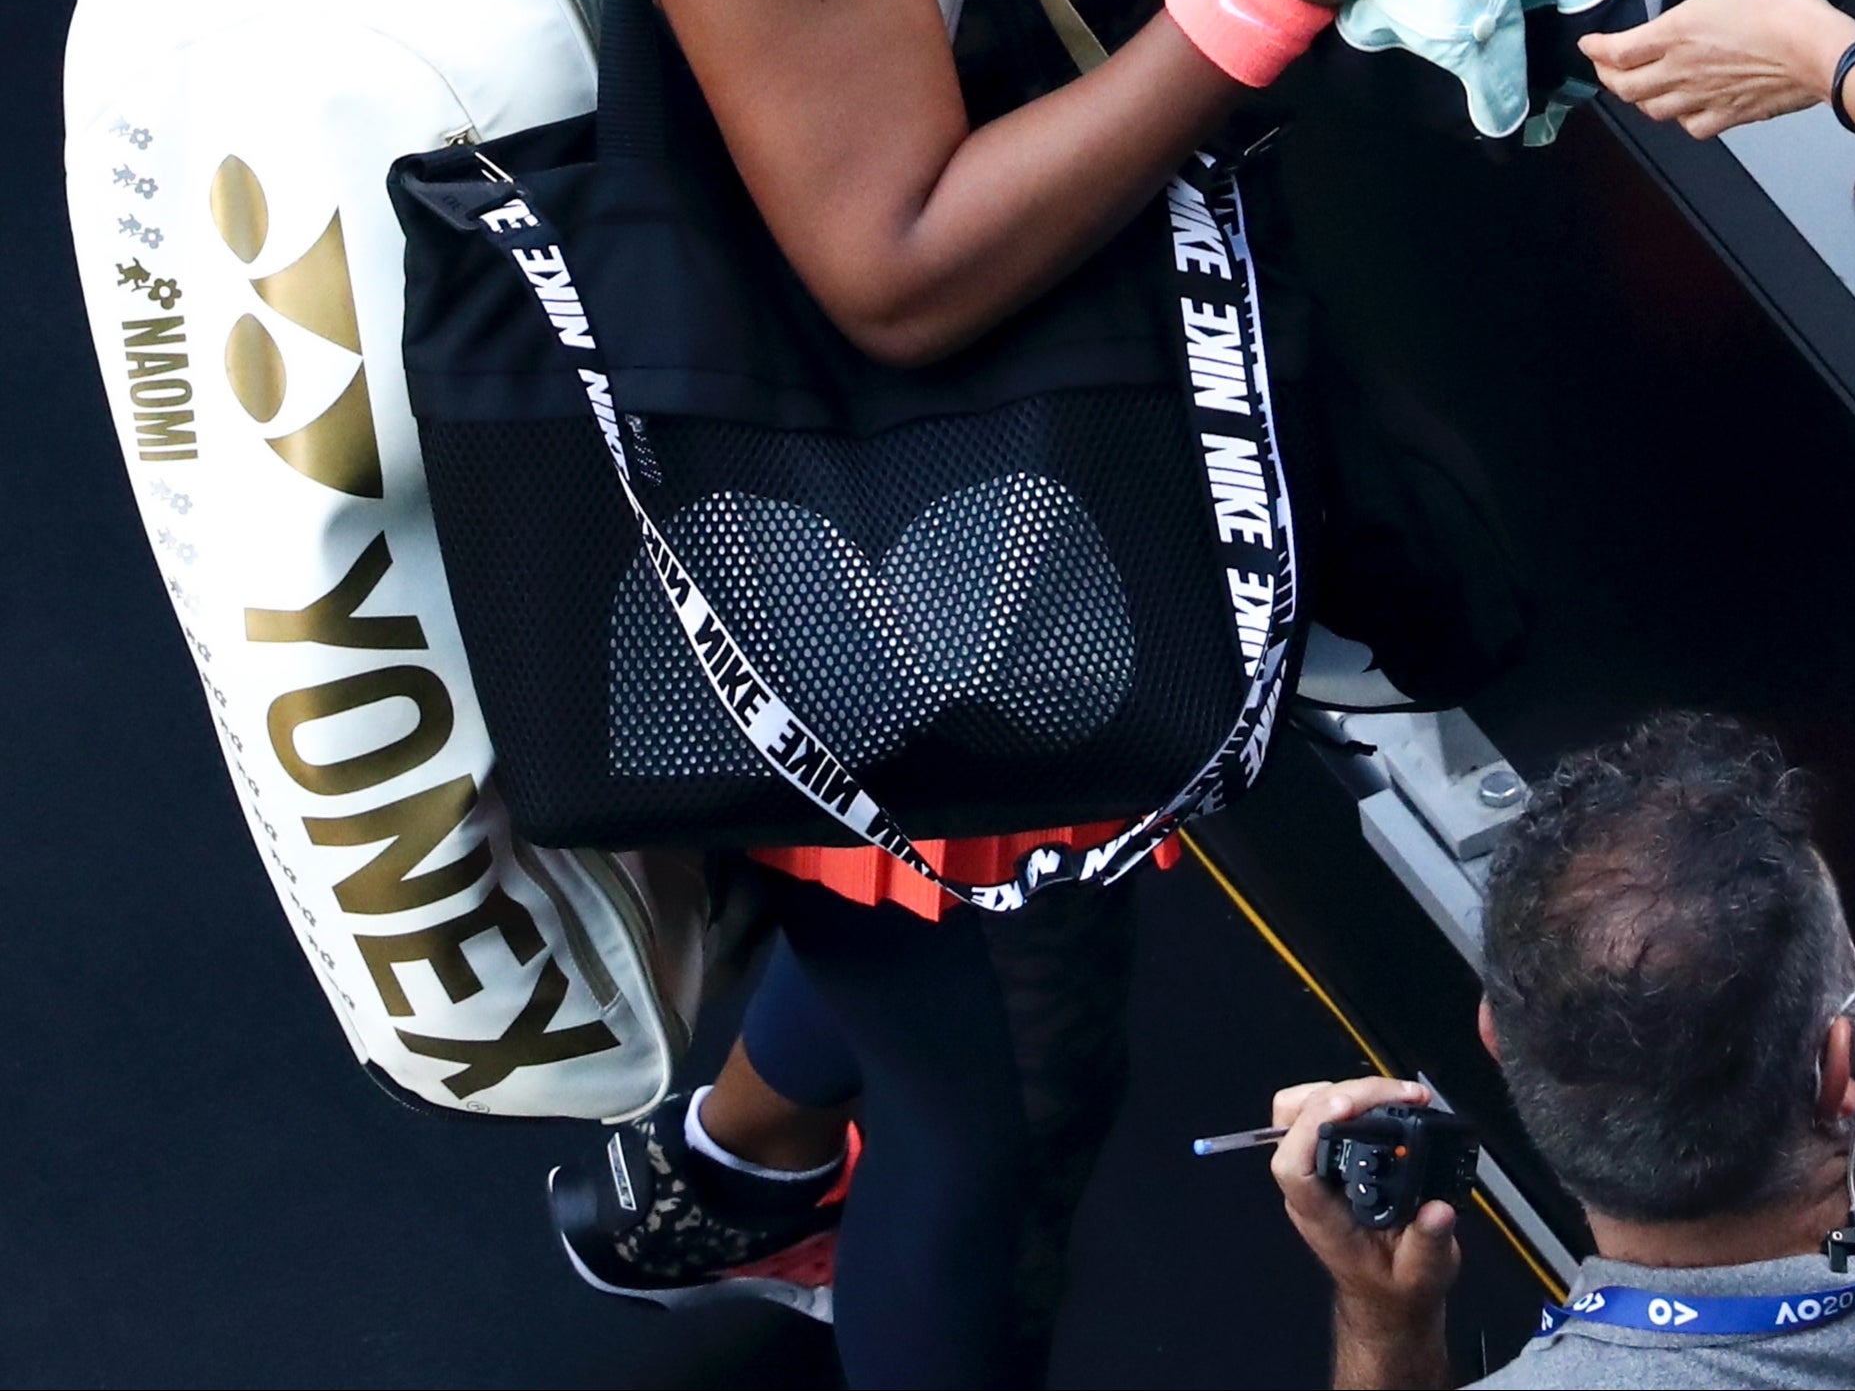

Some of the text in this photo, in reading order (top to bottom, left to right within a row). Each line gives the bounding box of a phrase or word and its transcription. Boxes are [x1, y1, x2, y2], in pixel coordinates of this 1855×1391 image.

[512, 244, 597, 350] NIKE
[1180, 296, 1252, 417] NIKE
[121, 315, 199, 461] NAOMI
[1200, 432, 1274, 551] NIKE
[694, 613, 772, 729] NIKE
[244, 530, 622, 1101] YONEX
[766, 718, 858, 812] NIKE
